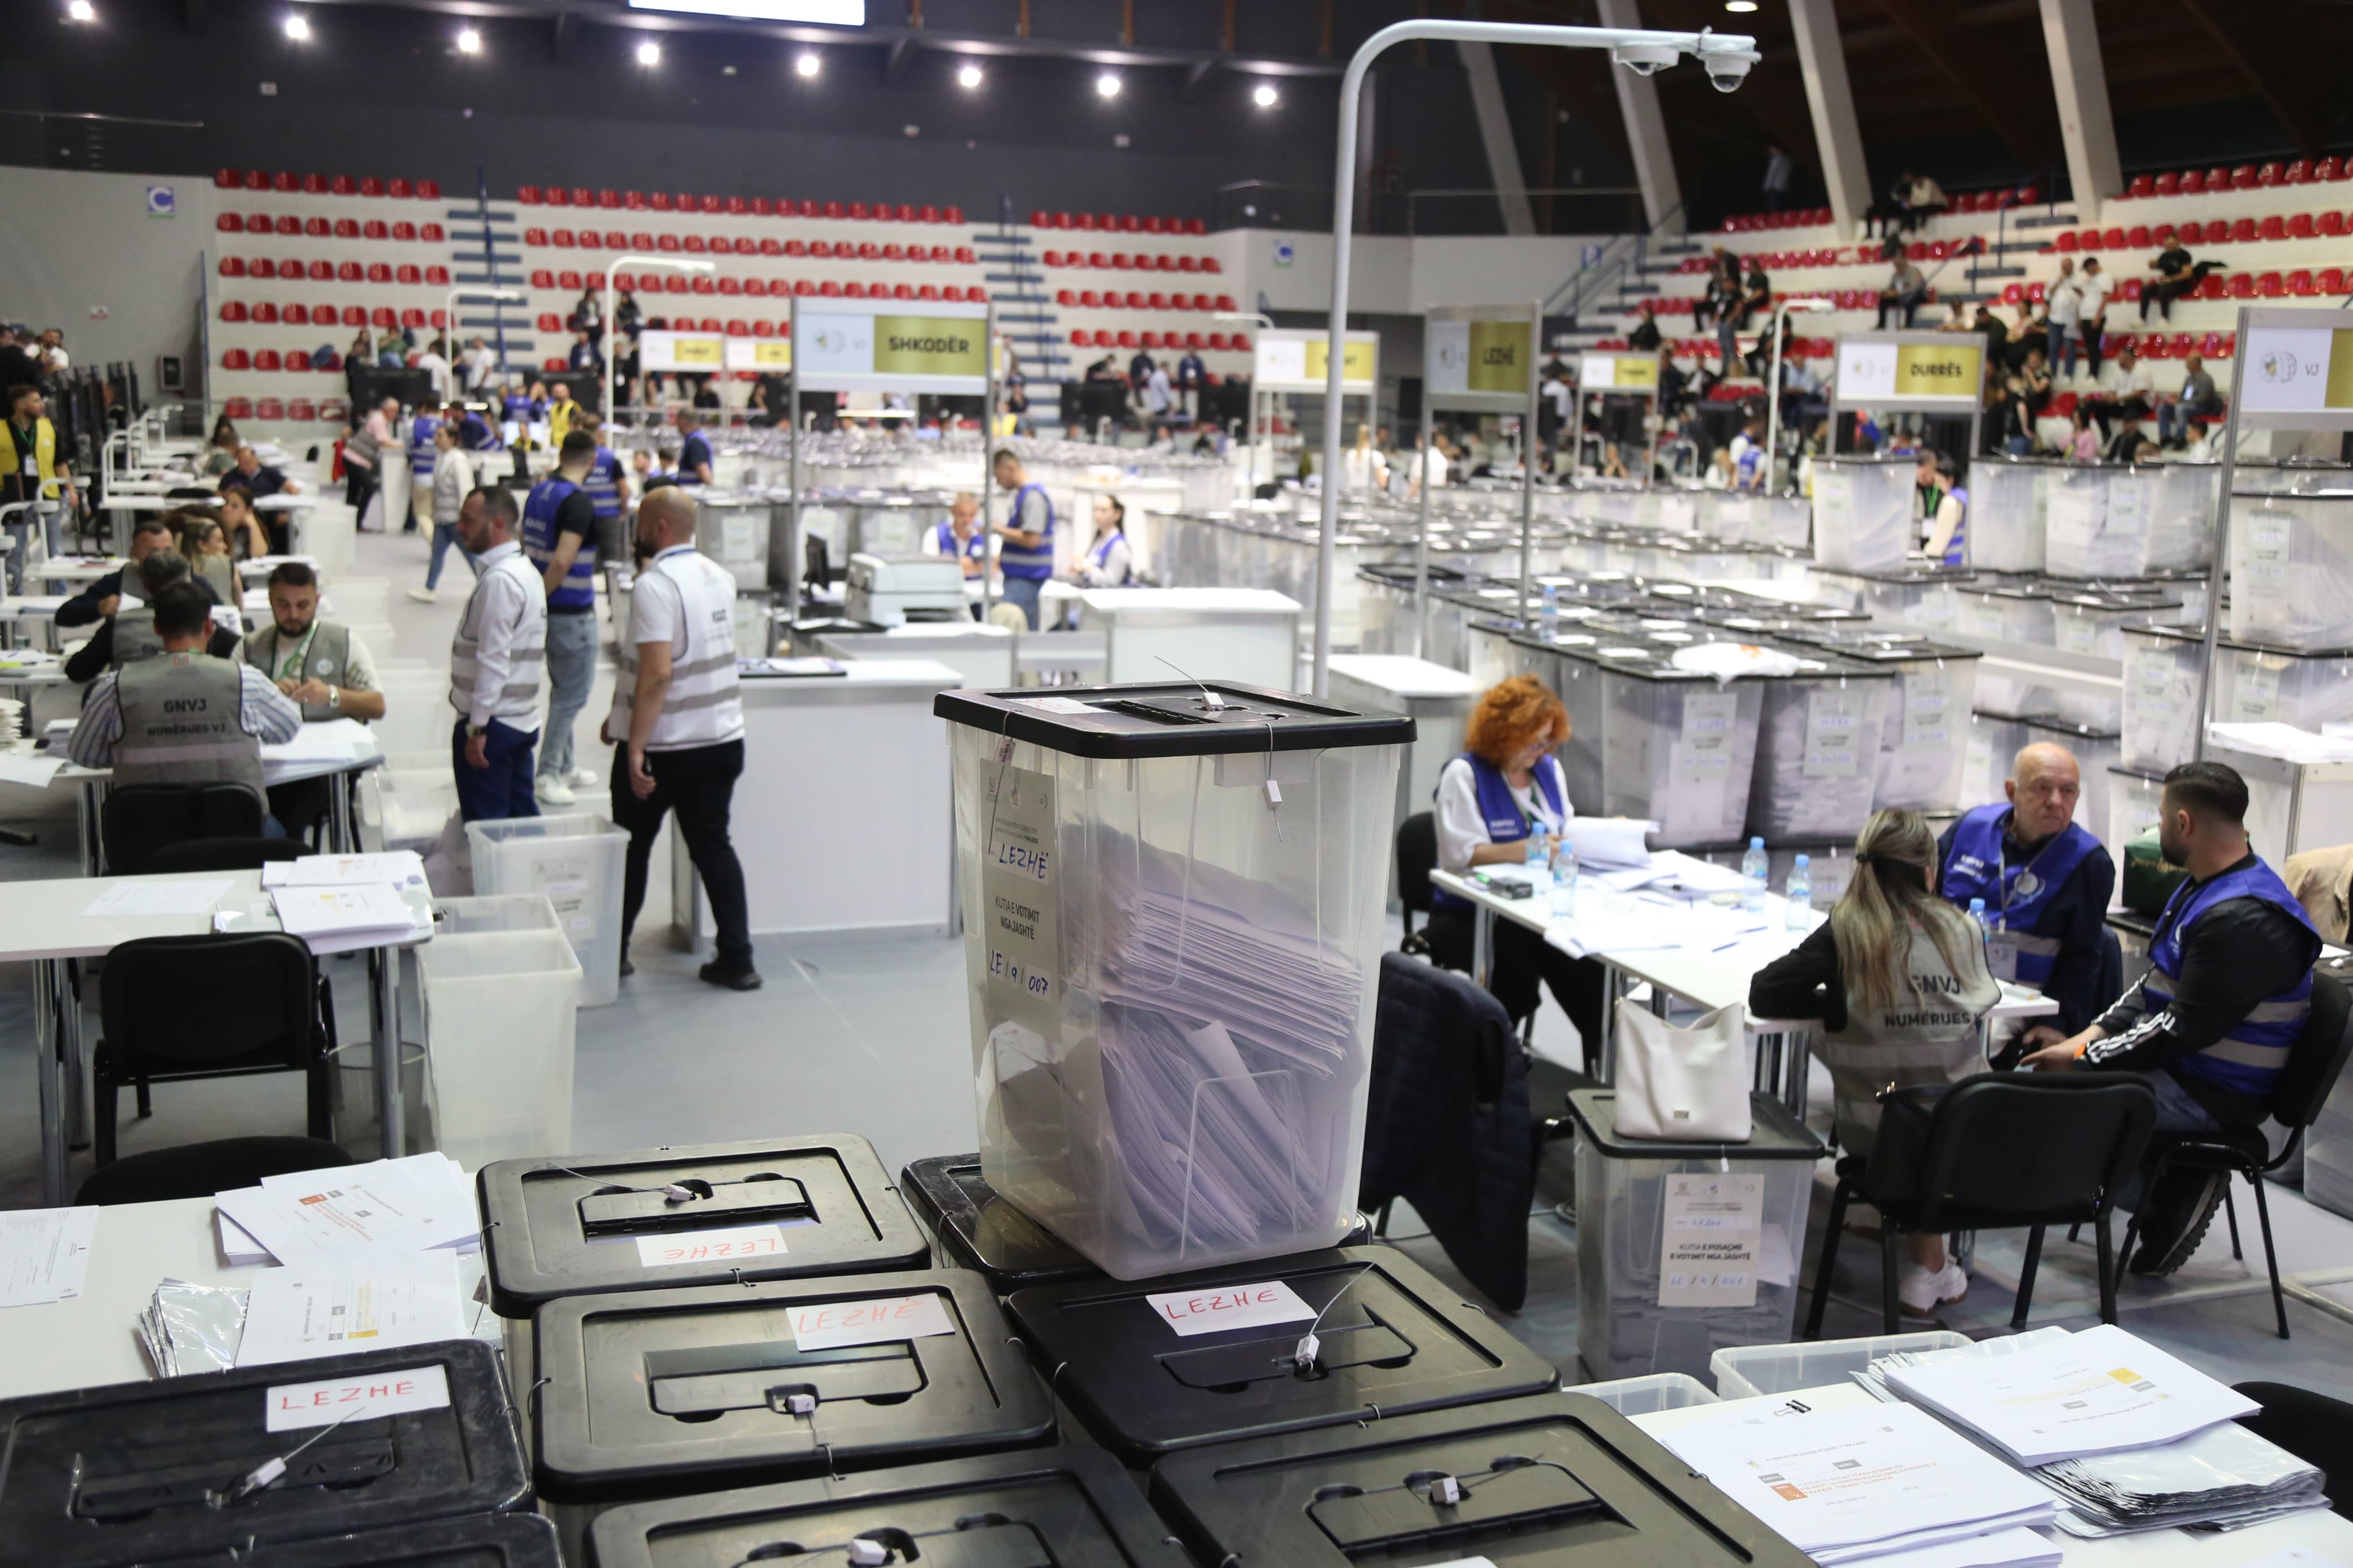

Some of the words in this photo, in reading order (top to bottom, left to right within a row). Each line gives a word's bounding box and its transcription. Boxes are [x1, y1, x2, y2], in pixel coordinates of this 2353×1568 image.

[889, 335, 970, 353] SHKODËR
[1910, 361, 1963, 378] DURRËS
[163, 698, 207, 713] GNVJ
[212, 723, 226, 733] VJ
[999, 843, 1048, 879] LEZHË
[996, 895, 1011, 913] KUTIA
[1011, 901, 1015, 914] E
[1015, 902, 1040, 923] VOTIMIT
[1001, 915, 1012, 931] NGA
[1012, 920, 1035, 940] JASHTË
[1029, 975, 1049, 996] 007
[663, 1238, 776, 1263] LEZHË
[1708, 1243, 1743, 1252] POSAÇME
[1723, 1251, 1751, 1260] JASHTË
[1165, 1286, 1278, 1319] LEZHË
[798, 1298, 926, 1333] LEZHË
[282, 1380, 415, 1410] LEZHË
